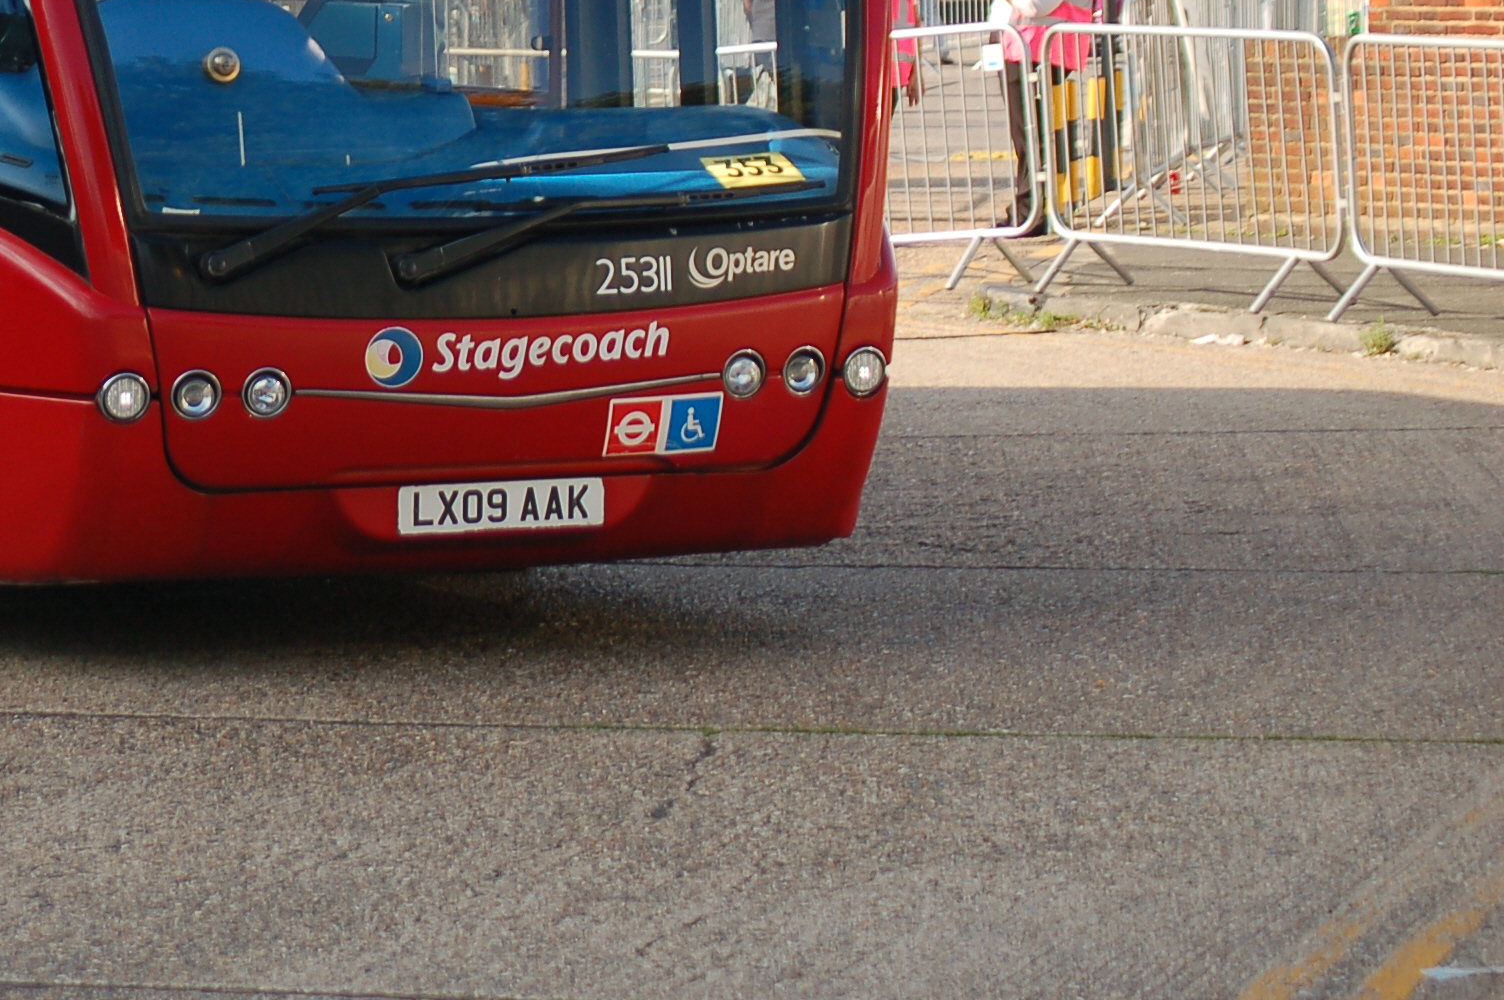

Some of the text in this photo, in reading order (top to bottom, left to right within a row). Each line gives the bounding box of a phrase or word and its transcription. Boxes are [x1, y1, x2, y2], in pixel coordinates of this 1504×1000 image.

[713, 155, 784, 178] 353
[596, 255, 673, 295] 25311
[704, 246, 796, 282] Optare
[432, 320, 670, 380] Stagecoach
[412, 484, 590, 527] LX09 AAK
